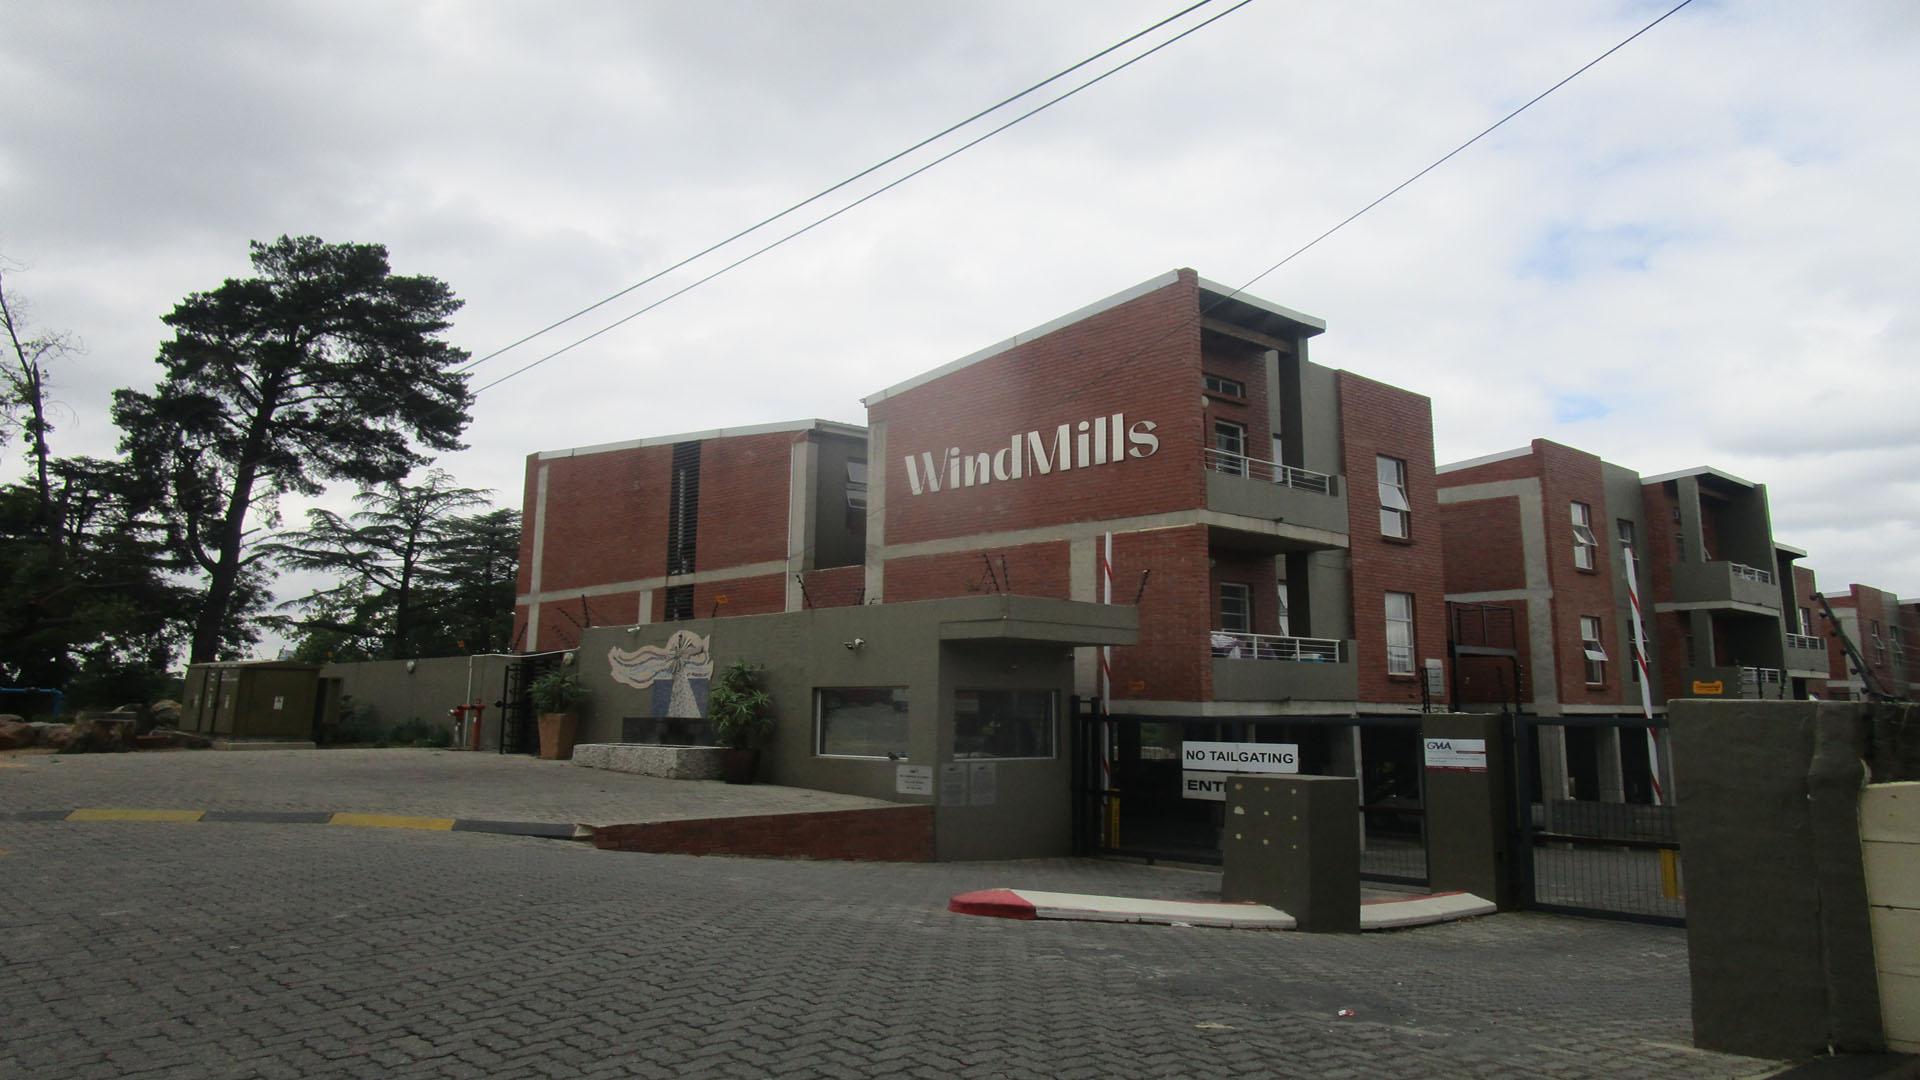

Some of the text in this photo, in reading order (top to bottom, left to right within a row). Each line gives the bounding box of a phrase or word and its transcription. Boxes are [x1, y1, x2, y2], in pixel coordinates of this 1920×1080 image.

[904, 413, 1160, 496] WindMills
[1186, 750, 1294, 764] NO TAILGATING
[1187, 779, 1227, 792] ENT
